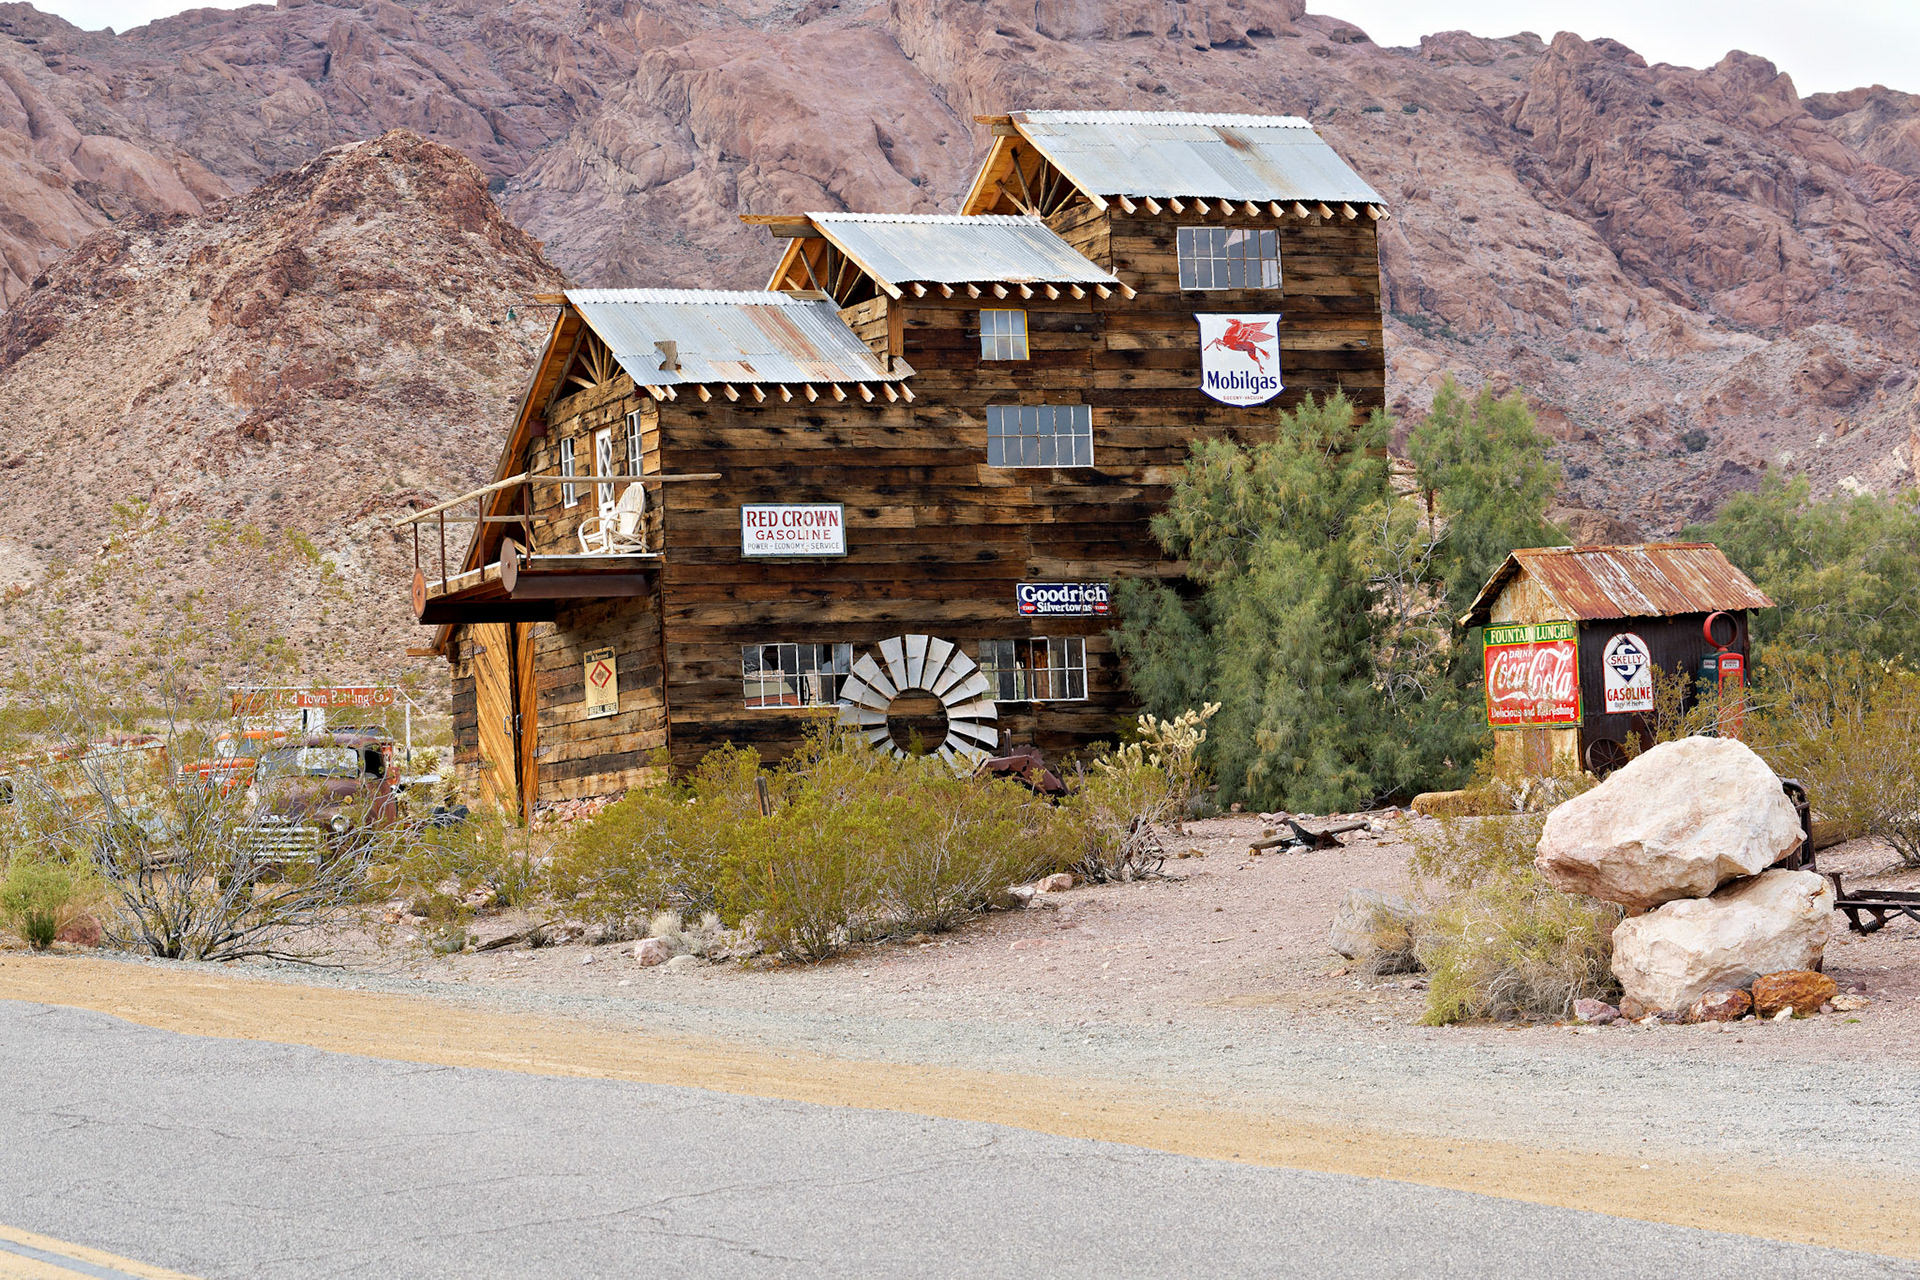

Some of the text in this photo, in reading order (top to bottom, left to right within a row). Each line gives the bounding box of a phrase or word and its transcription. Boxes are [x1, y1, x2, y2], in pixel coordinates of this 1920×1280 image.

[1207, 370, 1277, 394] Mobilgas
[746, 510, 839, 527] RED CROWN
[755, 529, 831, 540] GASOLINE
[747, 542, 769, 550] POWER
[774, 542, 805, 550] ECONOMY
[810, 542, 840, 550] SERVICE
[1021, 586, 1107, 602] Goodrich
[1037, 602, 1092, 612] Silvertowns
[1490, 624, 1567, 644] FOUNTAIN LUNCH
[1508, 650, 1534, 659] DRINK
[1611, 655, 1642, 665] SKELLY
[1489, 647, 1575, 702] Coca-Cola
[303, 692, 328, 704] Town
[1607, 687, 1651, 702] GASOLINE
